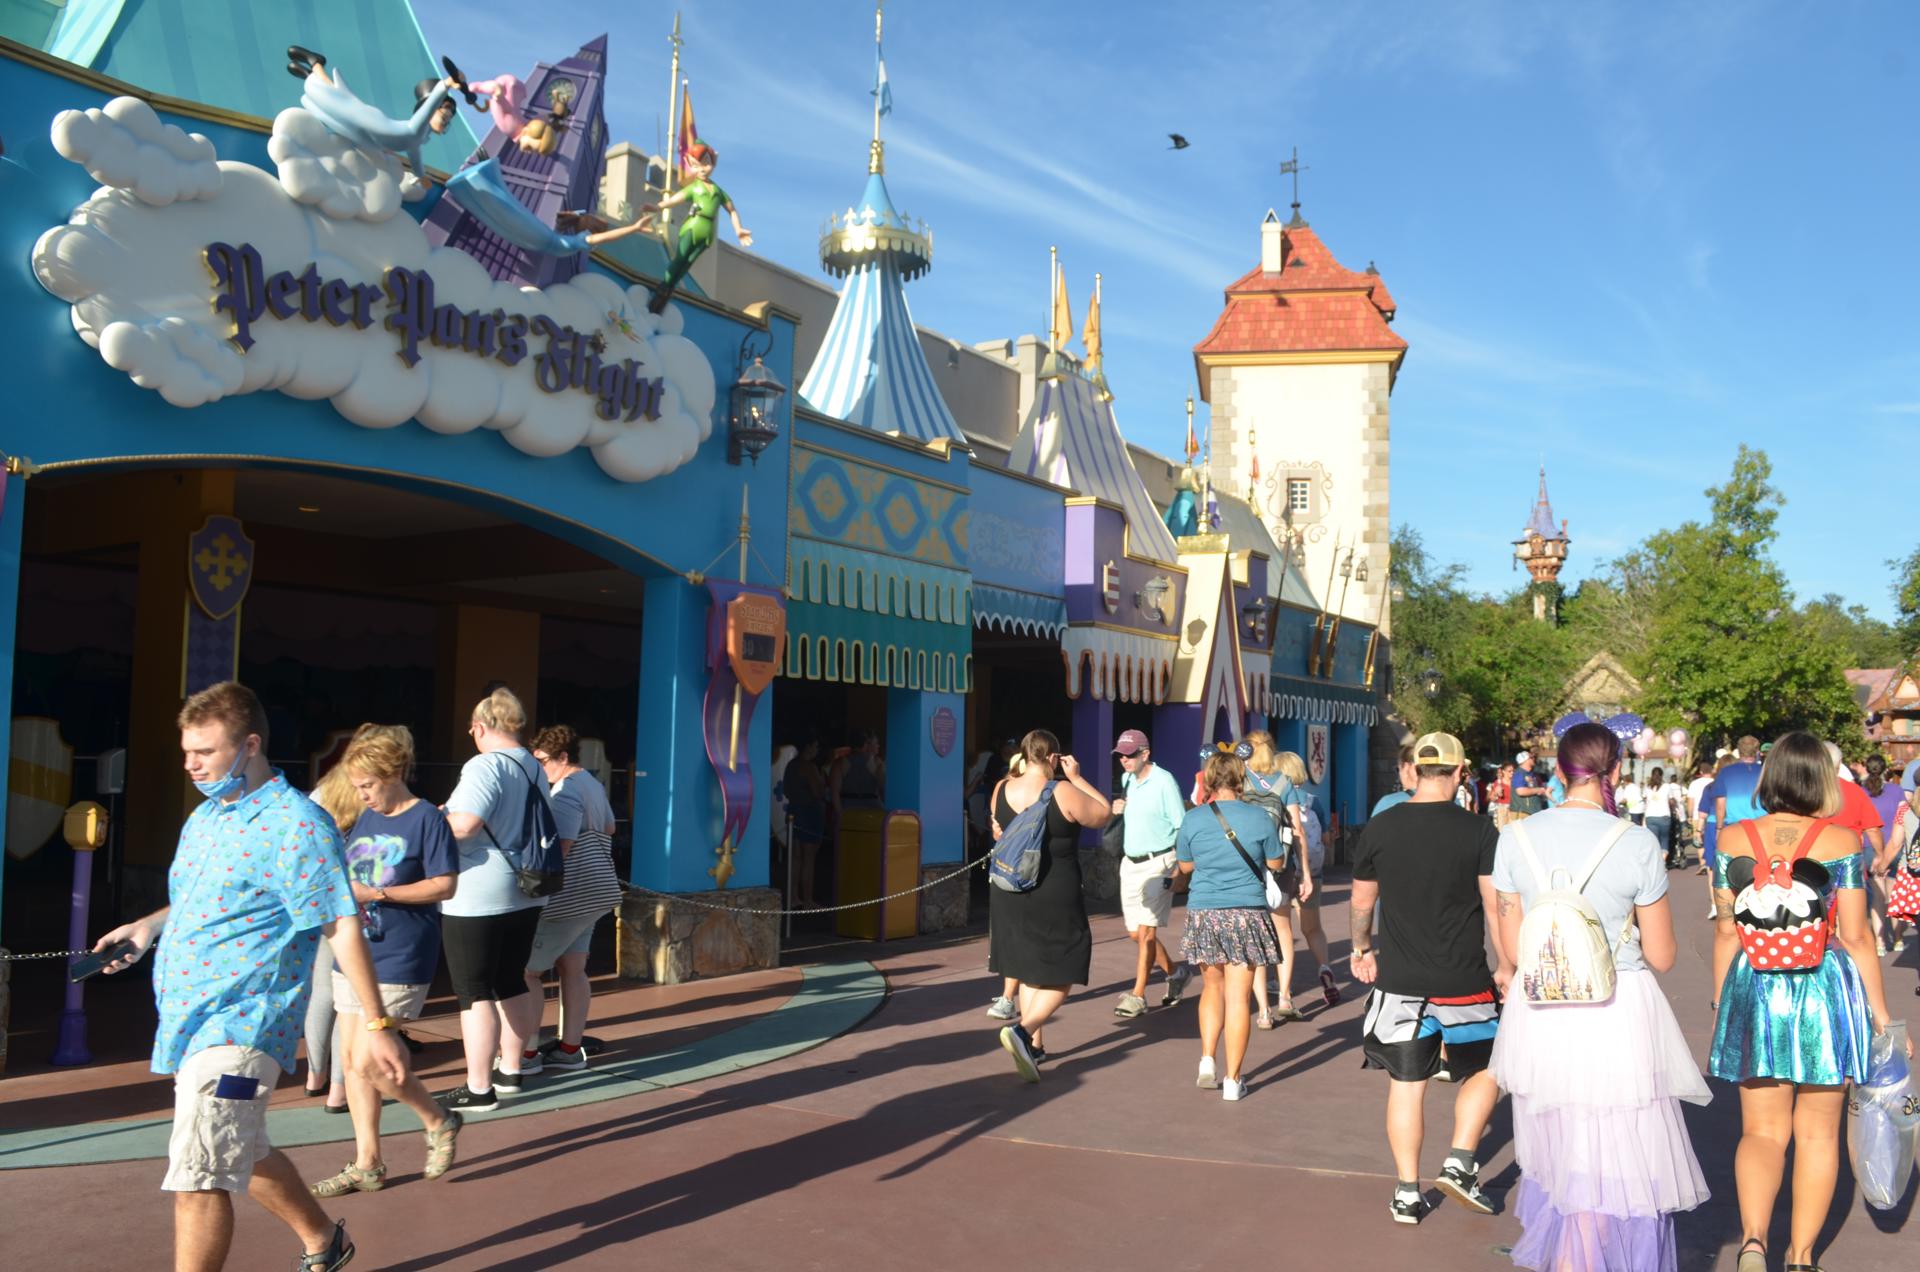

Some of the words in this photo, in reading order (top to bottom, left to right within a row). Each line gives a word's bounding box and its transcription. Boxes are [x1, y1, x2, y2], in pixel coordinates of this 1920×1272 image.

[203, 242, 385, 355] Peter
[383, 266, 528, 368] Pan's
[530, 314, 665, 421] Flight
